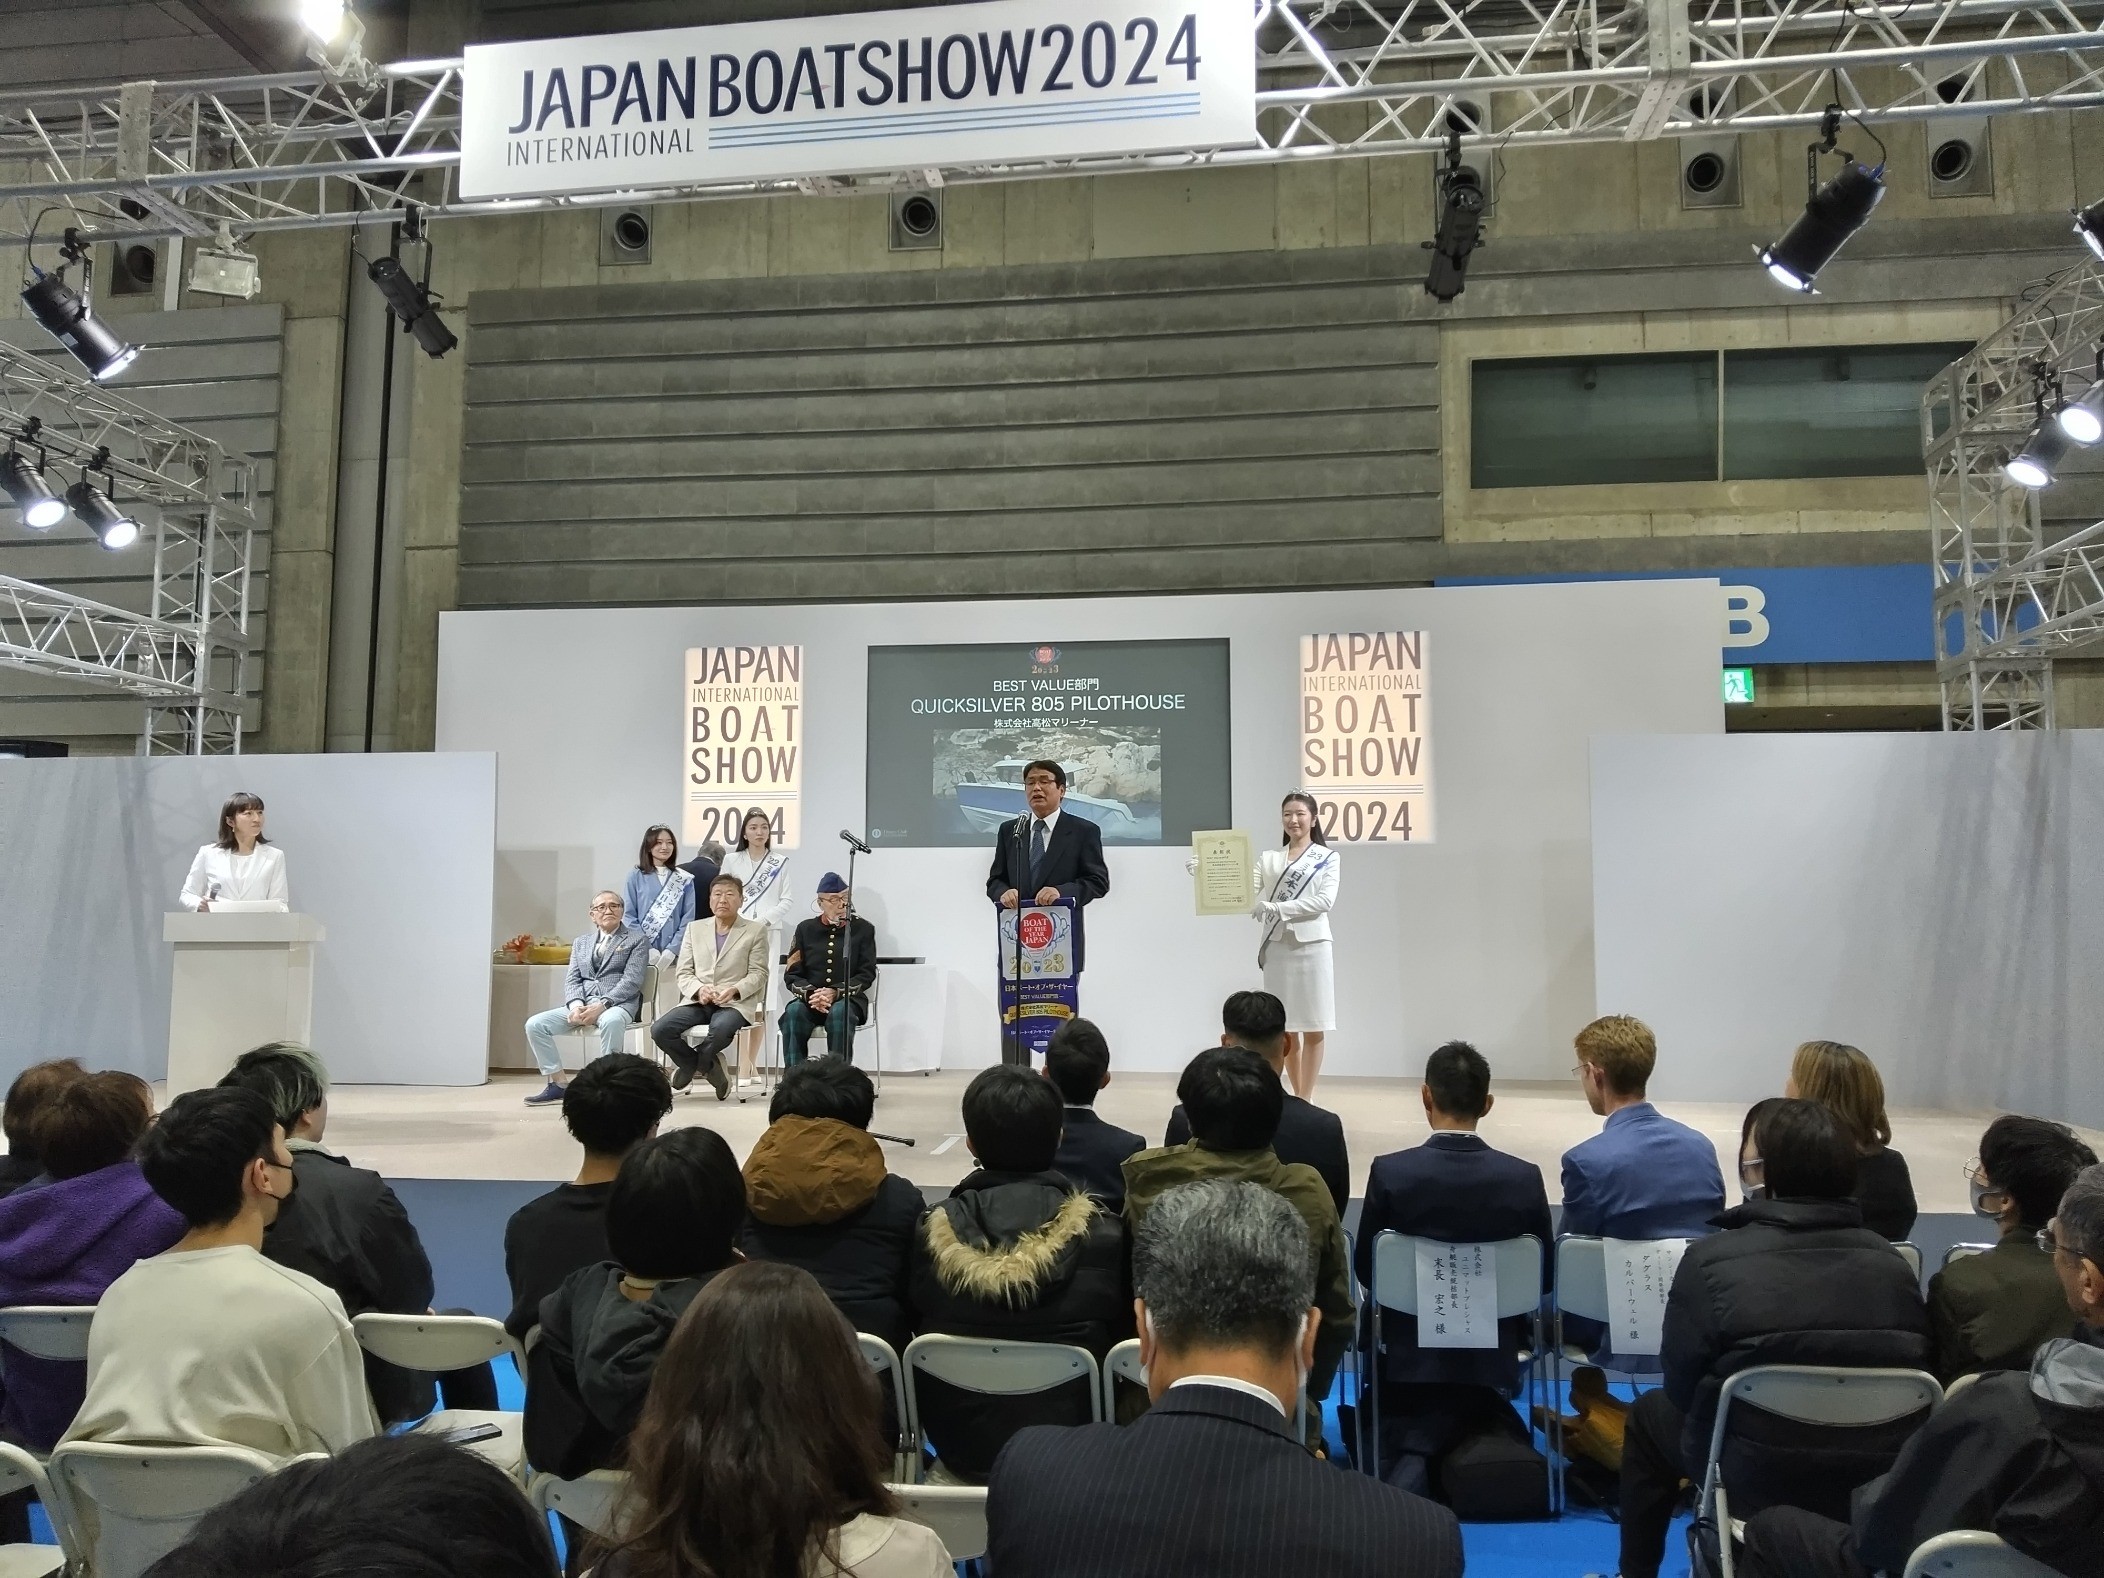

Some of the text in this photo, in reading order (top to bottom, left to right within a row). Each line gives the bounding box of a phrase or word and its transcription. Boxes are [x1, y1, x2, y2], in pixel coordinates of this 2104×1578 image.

[508, 56, 697, 134] JAPAN
[507, 127, 694, 166] INTERNATIONAL
[1720, 585, 1770, 647] B
[693, 645, 800, 685] JAPAN
[1304, 630, 1422, 673] JAPAN
[692, 686, 800, 703] INTERNATIONAL
[993, 680, 1028, 692] BEST
[1303, 674, 1422, 692] INTERNATIONAL
[911, 694, 1186, 714] QUICKSILVER 805 PILOTHOUSE
[1304, 693, 1422, 734] BOAT
[692, 705, 799, 743] BOAT
[690, 745, 797, 785] SHOW
[1304, 737, 1422, 778] SHOW
[702, 806, 785, 845] 204
[1319, 800, 1412, 842] 2024
[1023, 918, 1048, 927] BOAT
[1025, 936, 1048, 944] JAPAN
[1473, 1245, 1482, 1276] 株式会社
[1642, 1255, 1653, 1292] ダグラス
[1435, 1322, 1448, 1335] 様
[1629, 1330, 1640, 1340] 様
